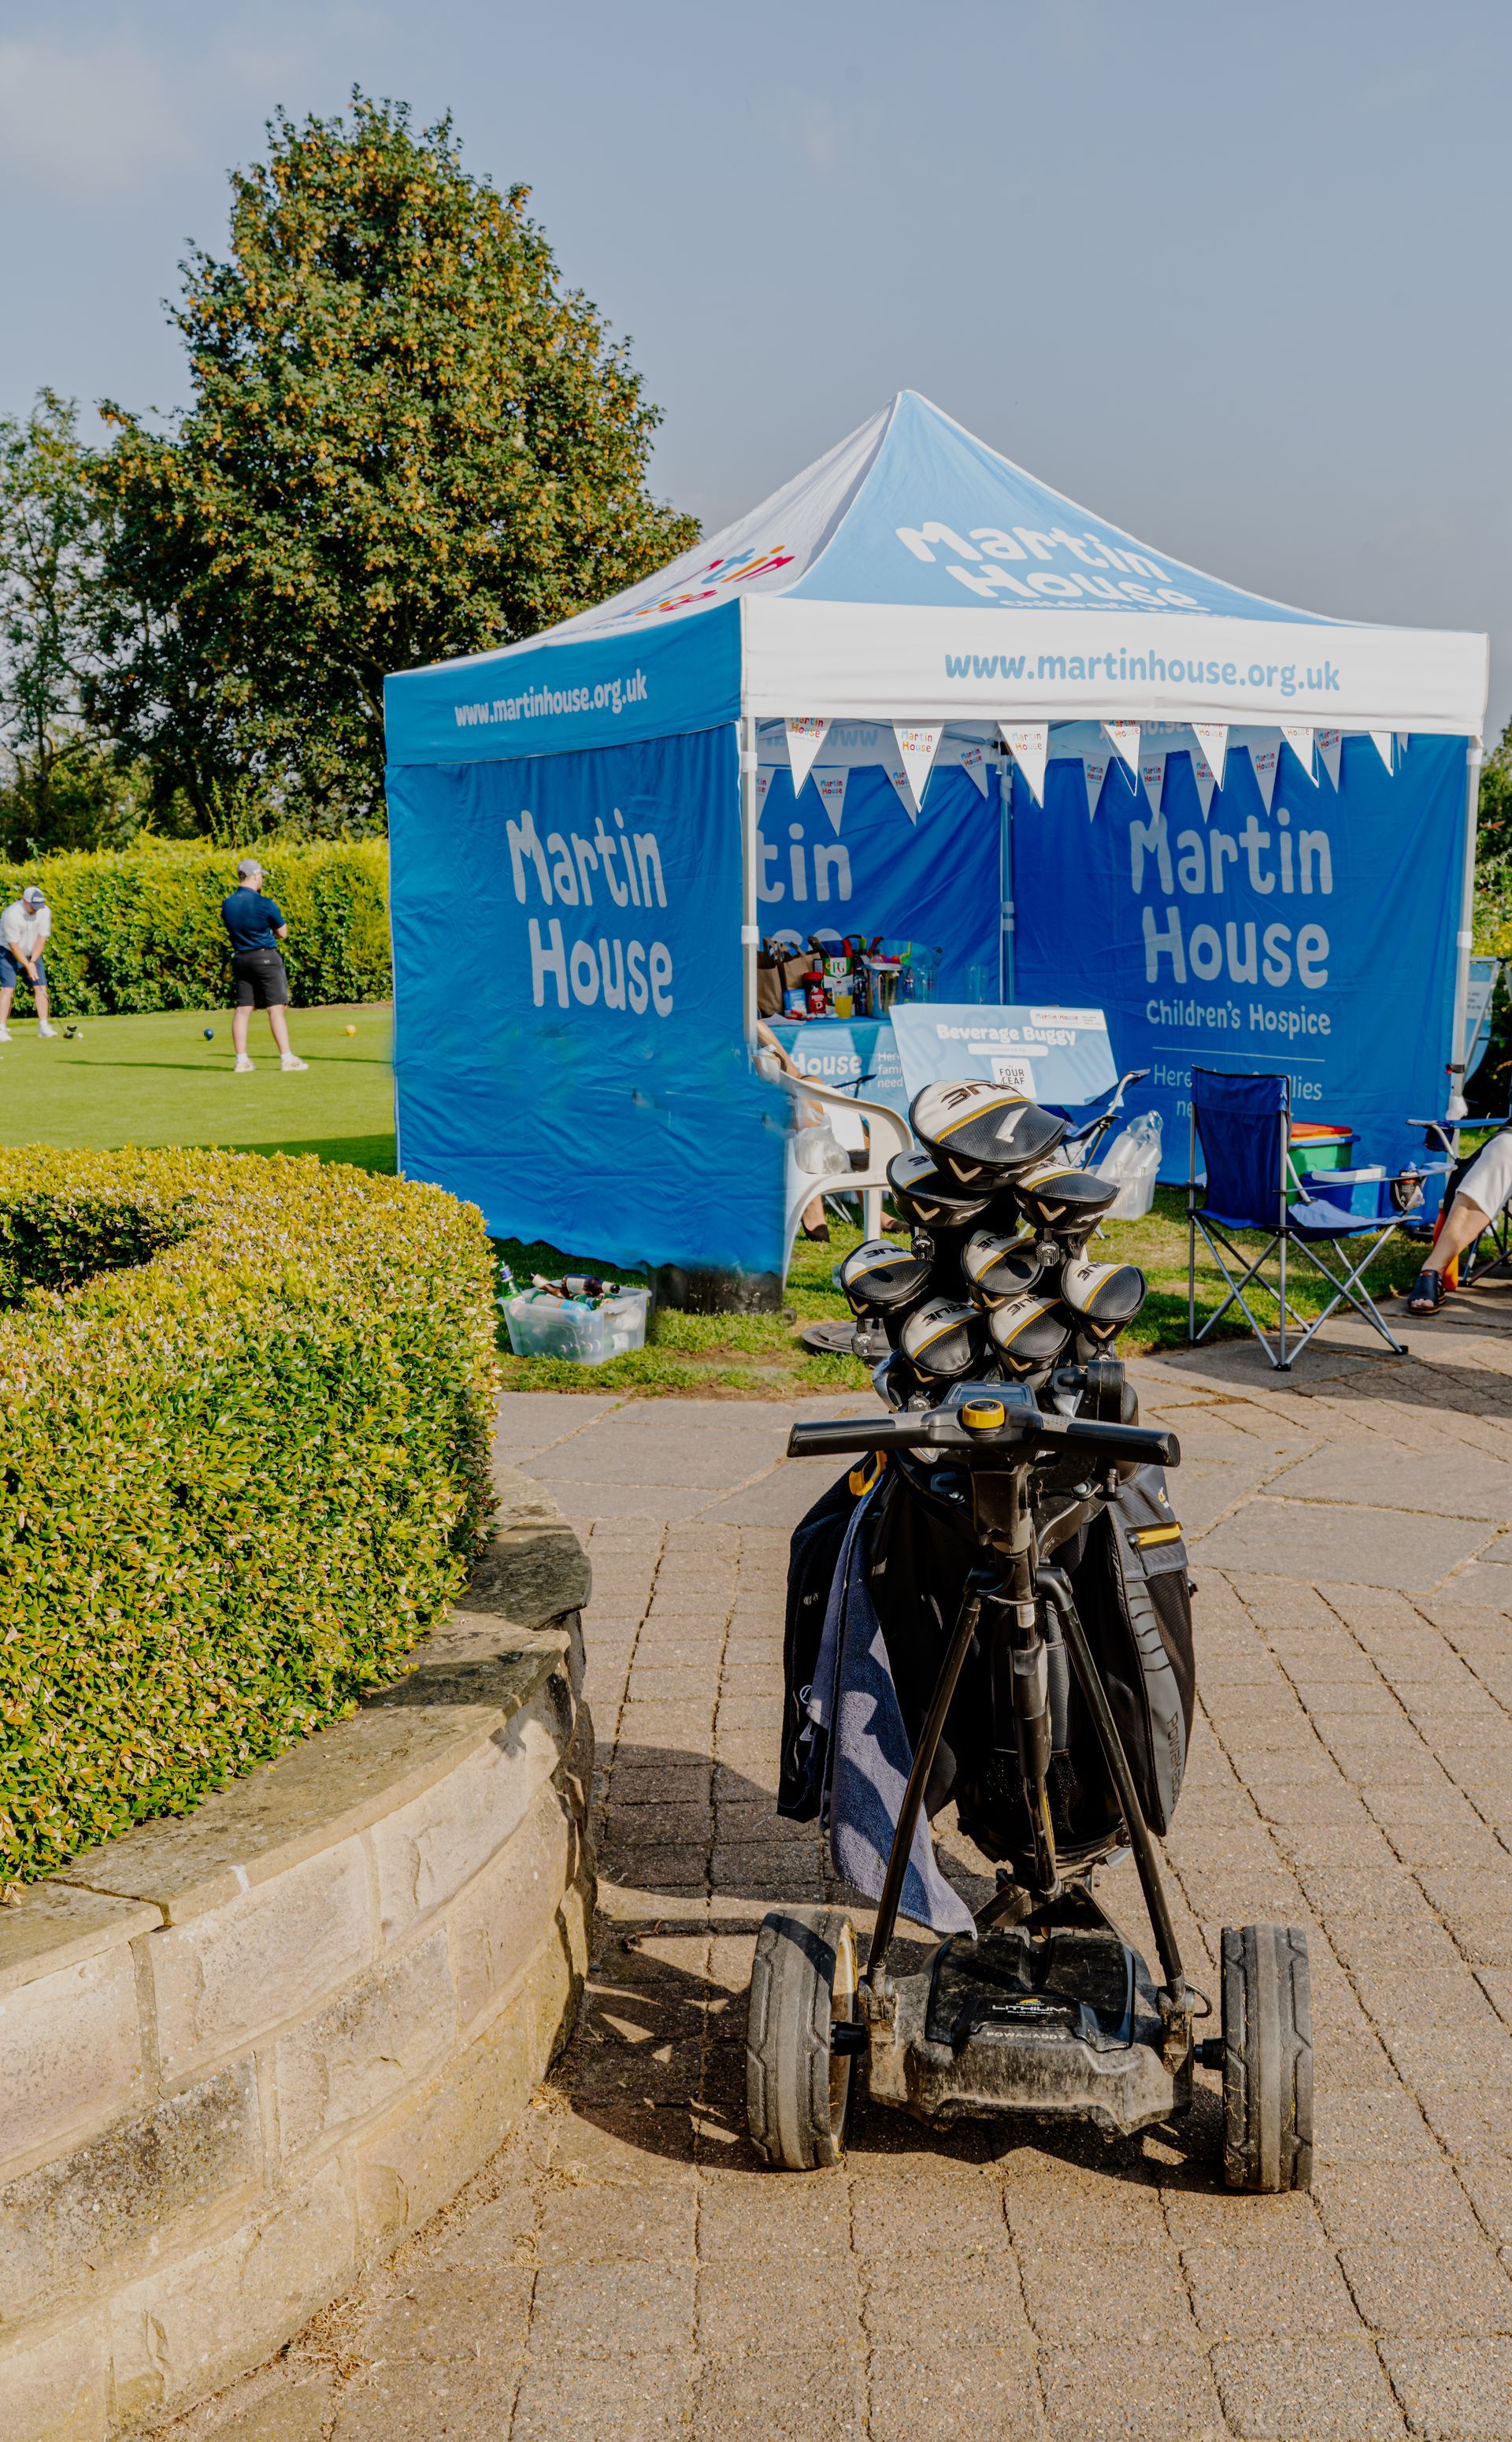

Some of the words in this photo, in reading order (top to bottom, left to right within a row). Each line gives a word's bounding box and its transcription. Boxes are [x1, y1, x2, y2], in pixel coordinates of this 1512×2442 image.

[895, 521, 1172, 582] Martin
[946, 565, 1211, 611] House
[945, 648, 1340, 696] www.martinhouse.org.uk
[454, 668, 647, 726] www.martinhouse.org.uk
[791, 722, 820, 737] House
[901, 730, 932, 742] Martin
[902, 740, 931, 752] House
[960, 748, 980, 759] Martin
[1255, 752, 1275, 762] Martin
[964, 755, 983, 767] House
[1256, 761, 1275, 770] House
[1087, 763, 1103, 773] Martin
[1143, 766, 1162, 774] Martin
[1087, 773, 1103, 781] House
[822, 786, 843, 795] House
[506, 807, 667, 907] Martin
[1129, 807, 1333, 895] Martin
[1143, 906, 1329, 989] House
[528, 918, 673, 1018] House
[1147, 1000, 1241, 1030] Children's
[1249, 1003, 1332, 1041] Hospice
[936, 1023, 1019, 1044] Beverage
[1022, 1026, 1076, 1046] Buggy
[789, 1052, 862, 1075] House
[999, 1068, 1025, 1077] FOUR
[1000, 1076, 1025, 1085] LEAF
